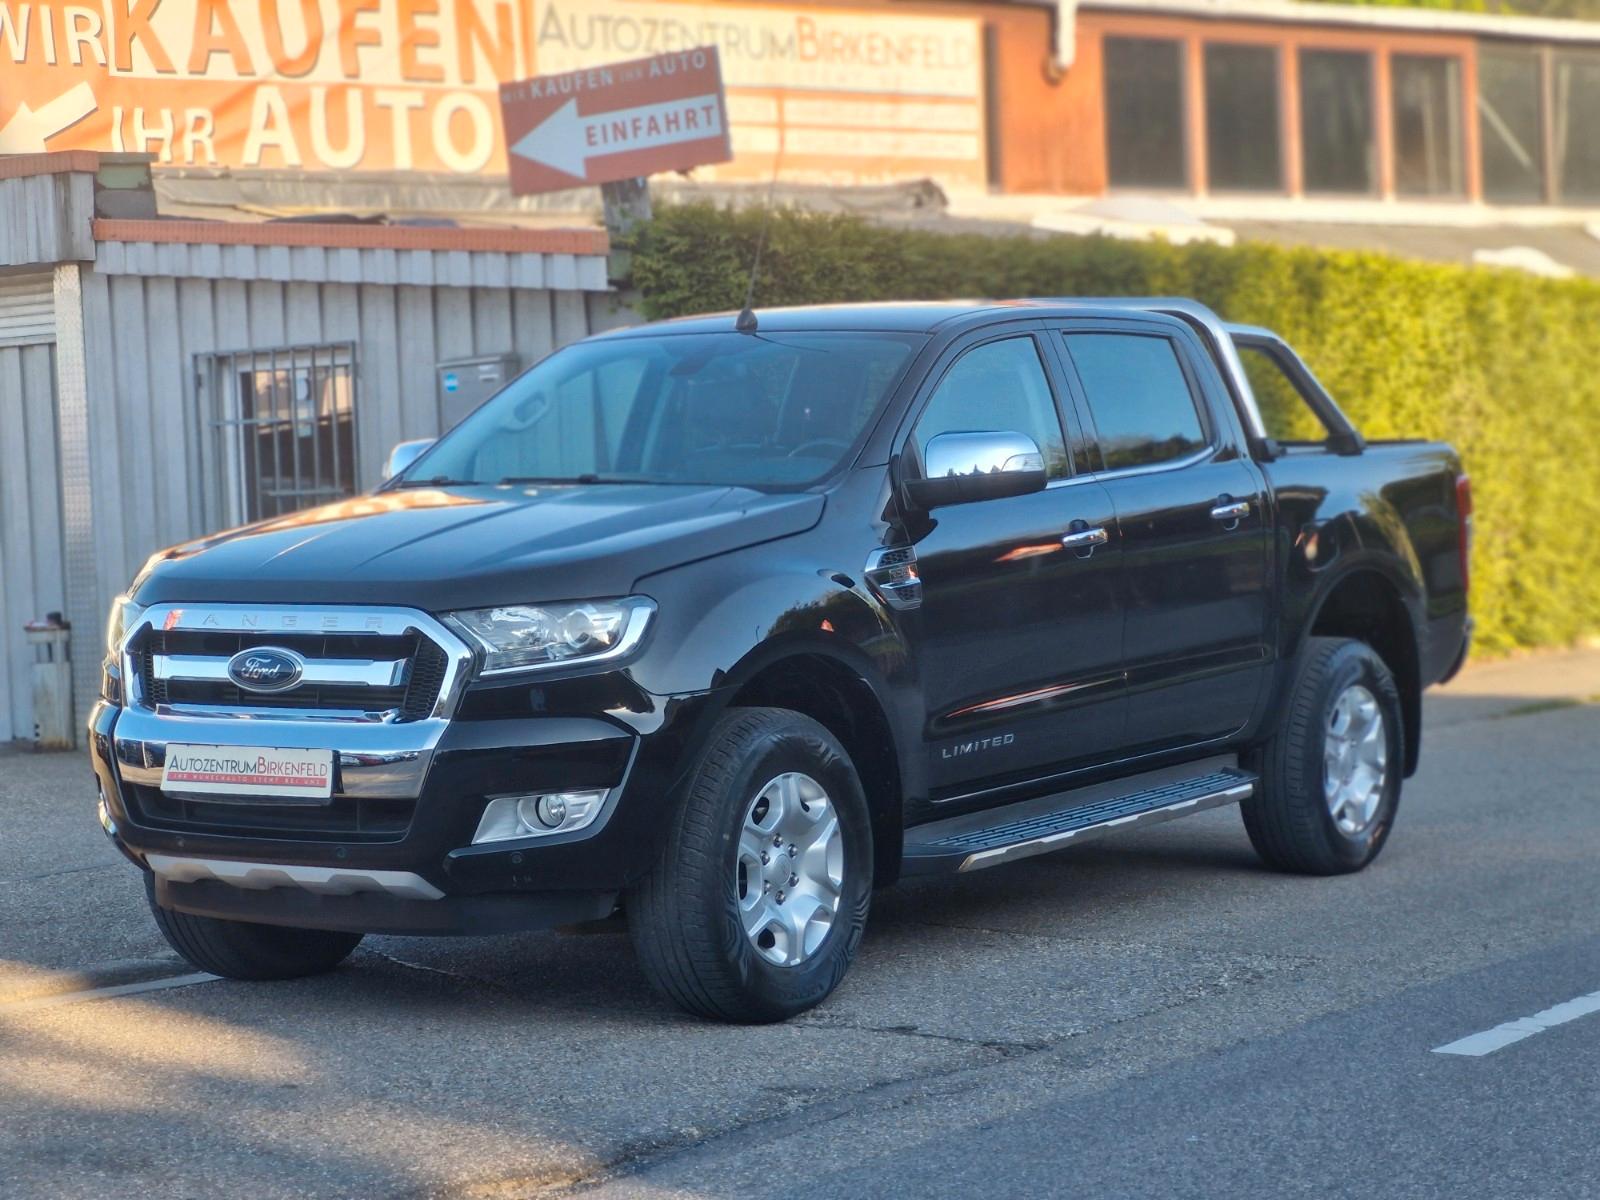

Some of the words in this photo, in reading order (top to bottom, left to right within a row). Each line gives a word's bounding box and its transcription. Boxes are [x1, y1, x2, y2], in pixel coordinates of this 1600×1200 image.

[113, 0, 516, 85] KAUFEN
[530, 70, 614, 100] KAUFEN
[649, 51, 707, 78] AUTO
[110, 106, 217, 165] IHR
[241, 85, 495, 173] AUTO
[585, 105, 715, 148] EINFAHRT
[241, 656, 281, 680] Ford
[942, 733, 1015, 759] LIMITED
